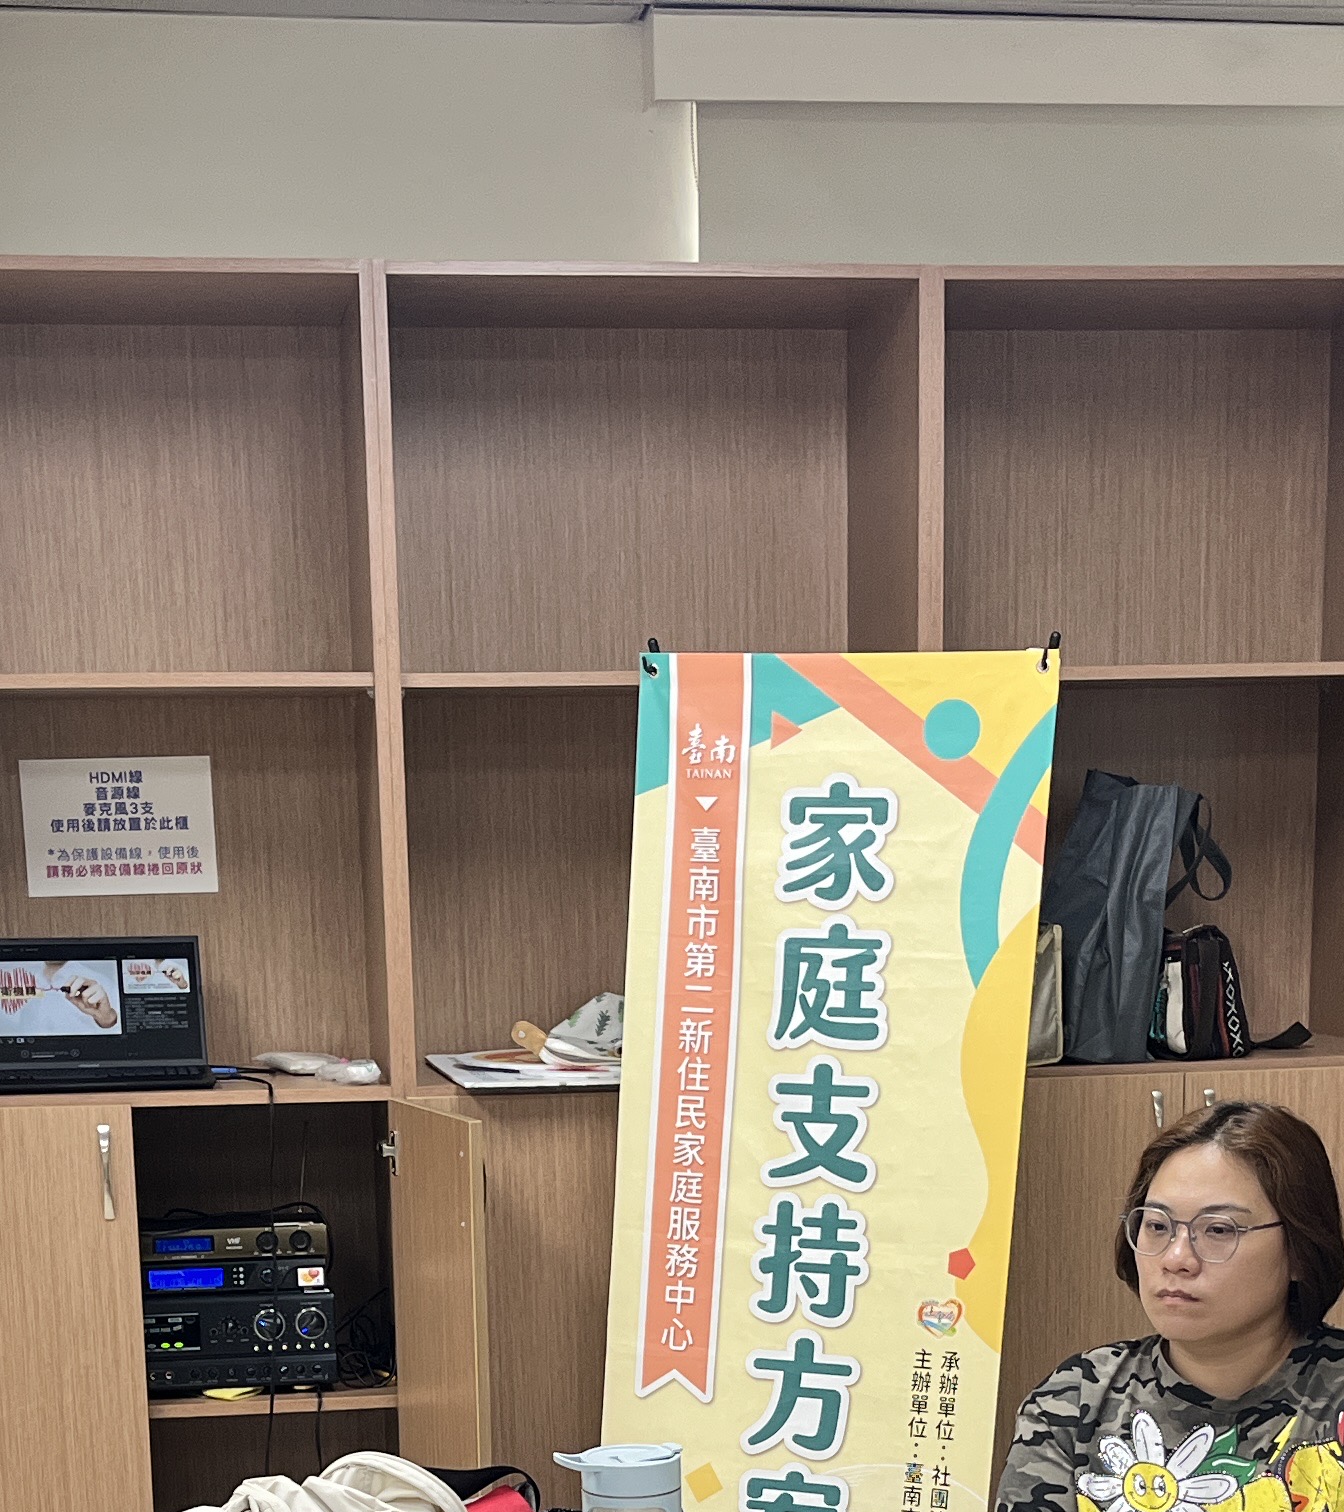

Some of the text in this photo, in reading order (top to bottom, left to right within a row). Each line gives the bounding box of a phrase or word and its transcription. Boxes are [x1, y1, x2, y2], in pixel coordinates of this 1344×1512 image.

[89, 770, 143, 784] HDMI線
[685, 767, 733, 780] TAINAN
[95, 786, 140, 800] 音源線
[82, 801, 154, 816] 麥克風3支
[50, 816, 189, 833] 使用後請放置於此櫃
[660, 825, 721, 1352] 臺南市第二新住民家庭服務中心
